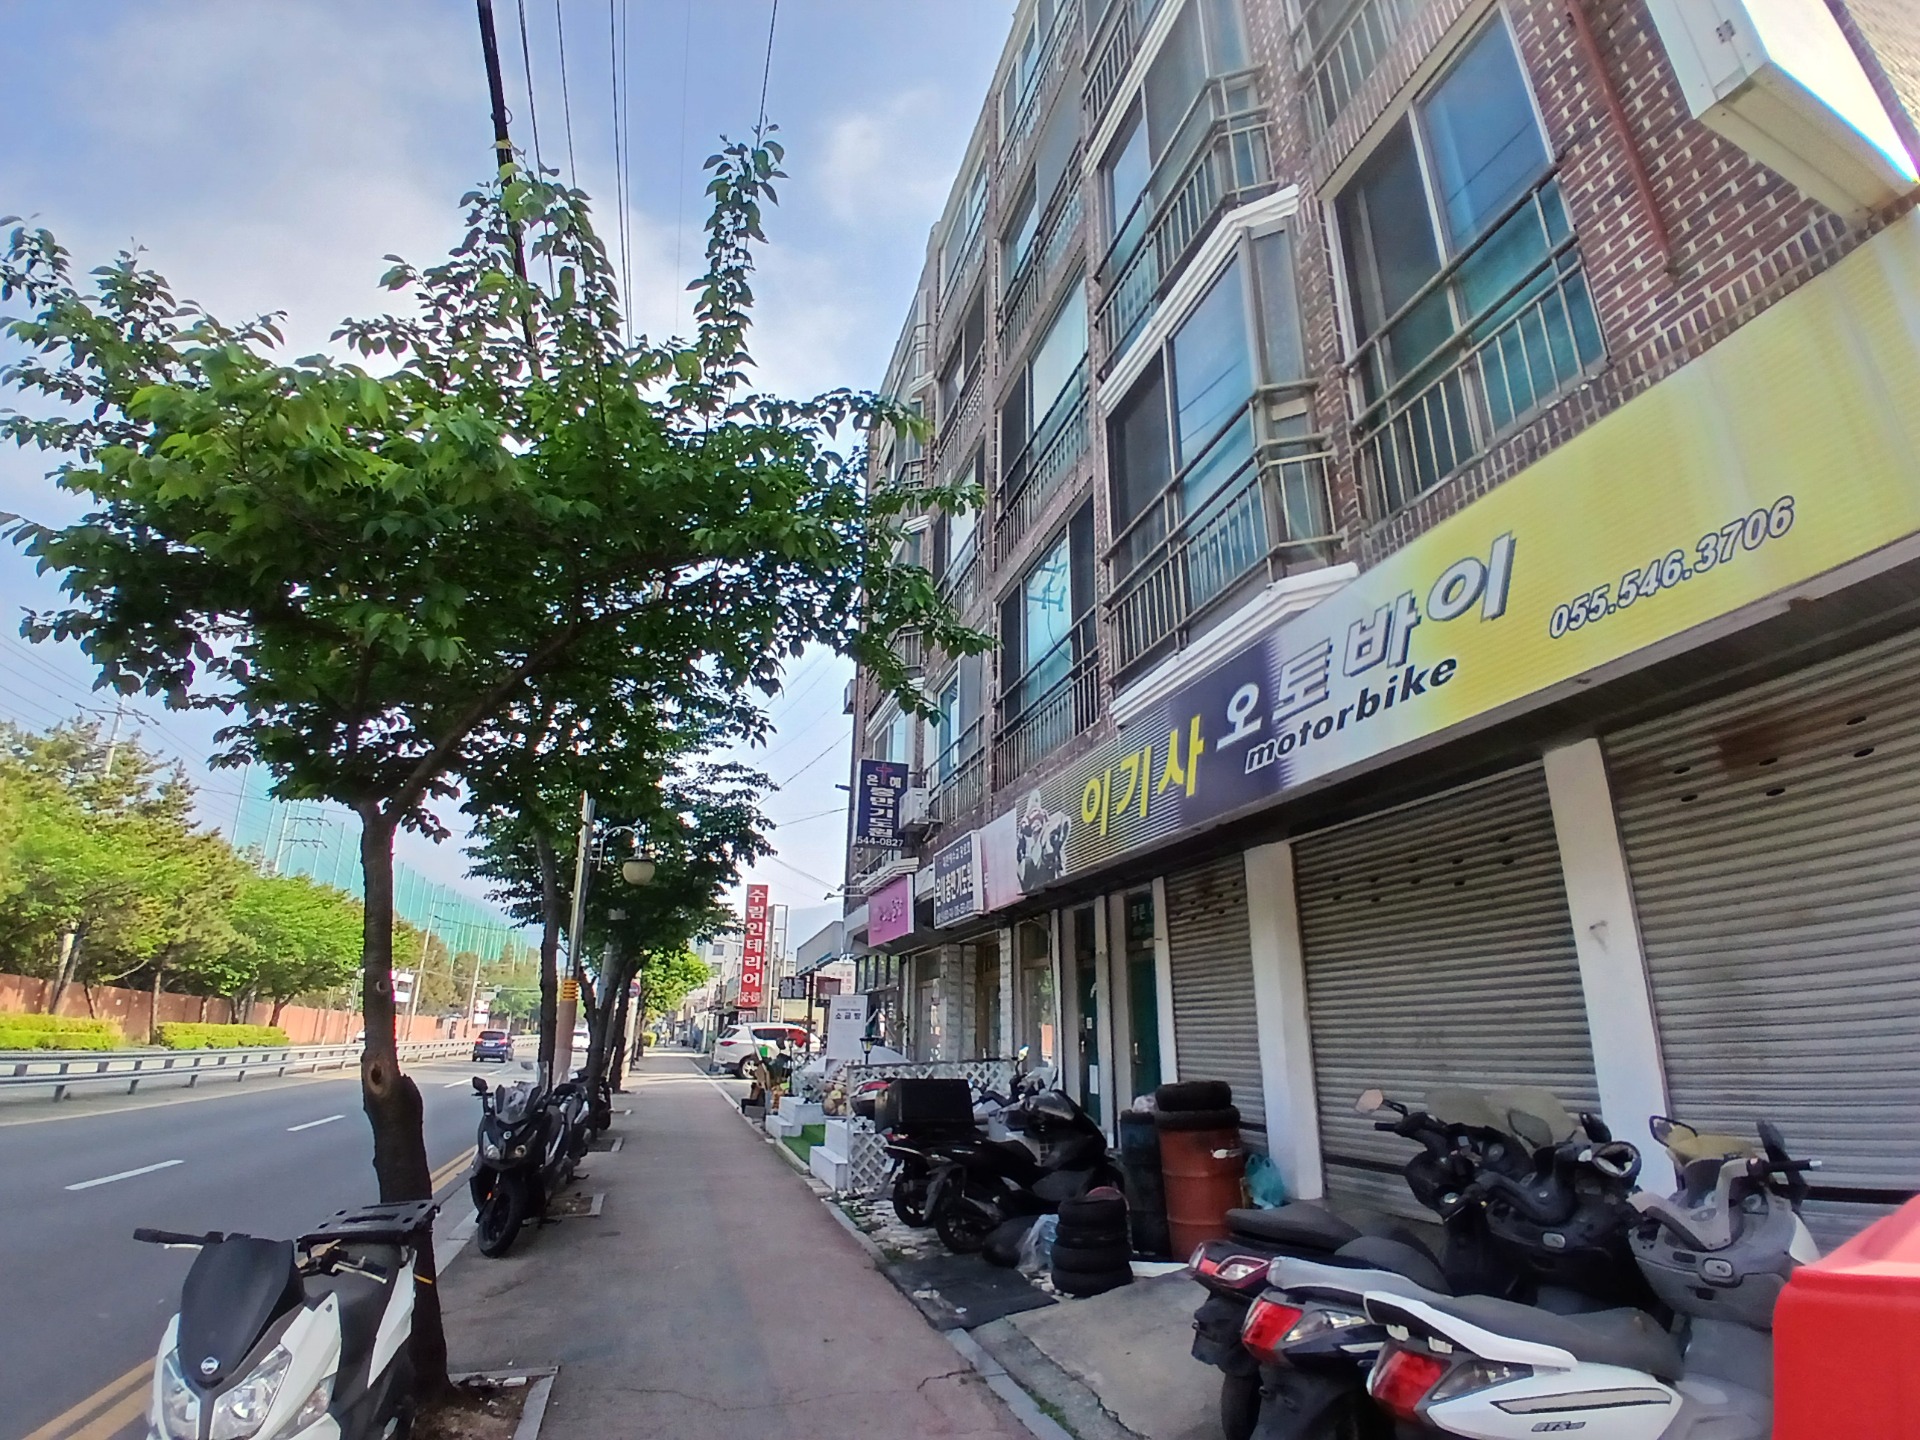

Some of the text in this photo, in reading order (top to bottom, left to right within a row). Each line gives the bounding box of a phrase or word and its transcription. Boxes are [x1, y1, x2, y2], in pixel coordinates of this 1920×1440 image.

[1549, 495, 1796, 640] 055.546.3706
[1080, 531, 1517, 836] 이기사 오토바이
[1244, 655, 1458, 775] motorbike
[857, 836, 904, 847] 544-0827
[743, 889, 766, 987] 수림인테리어
